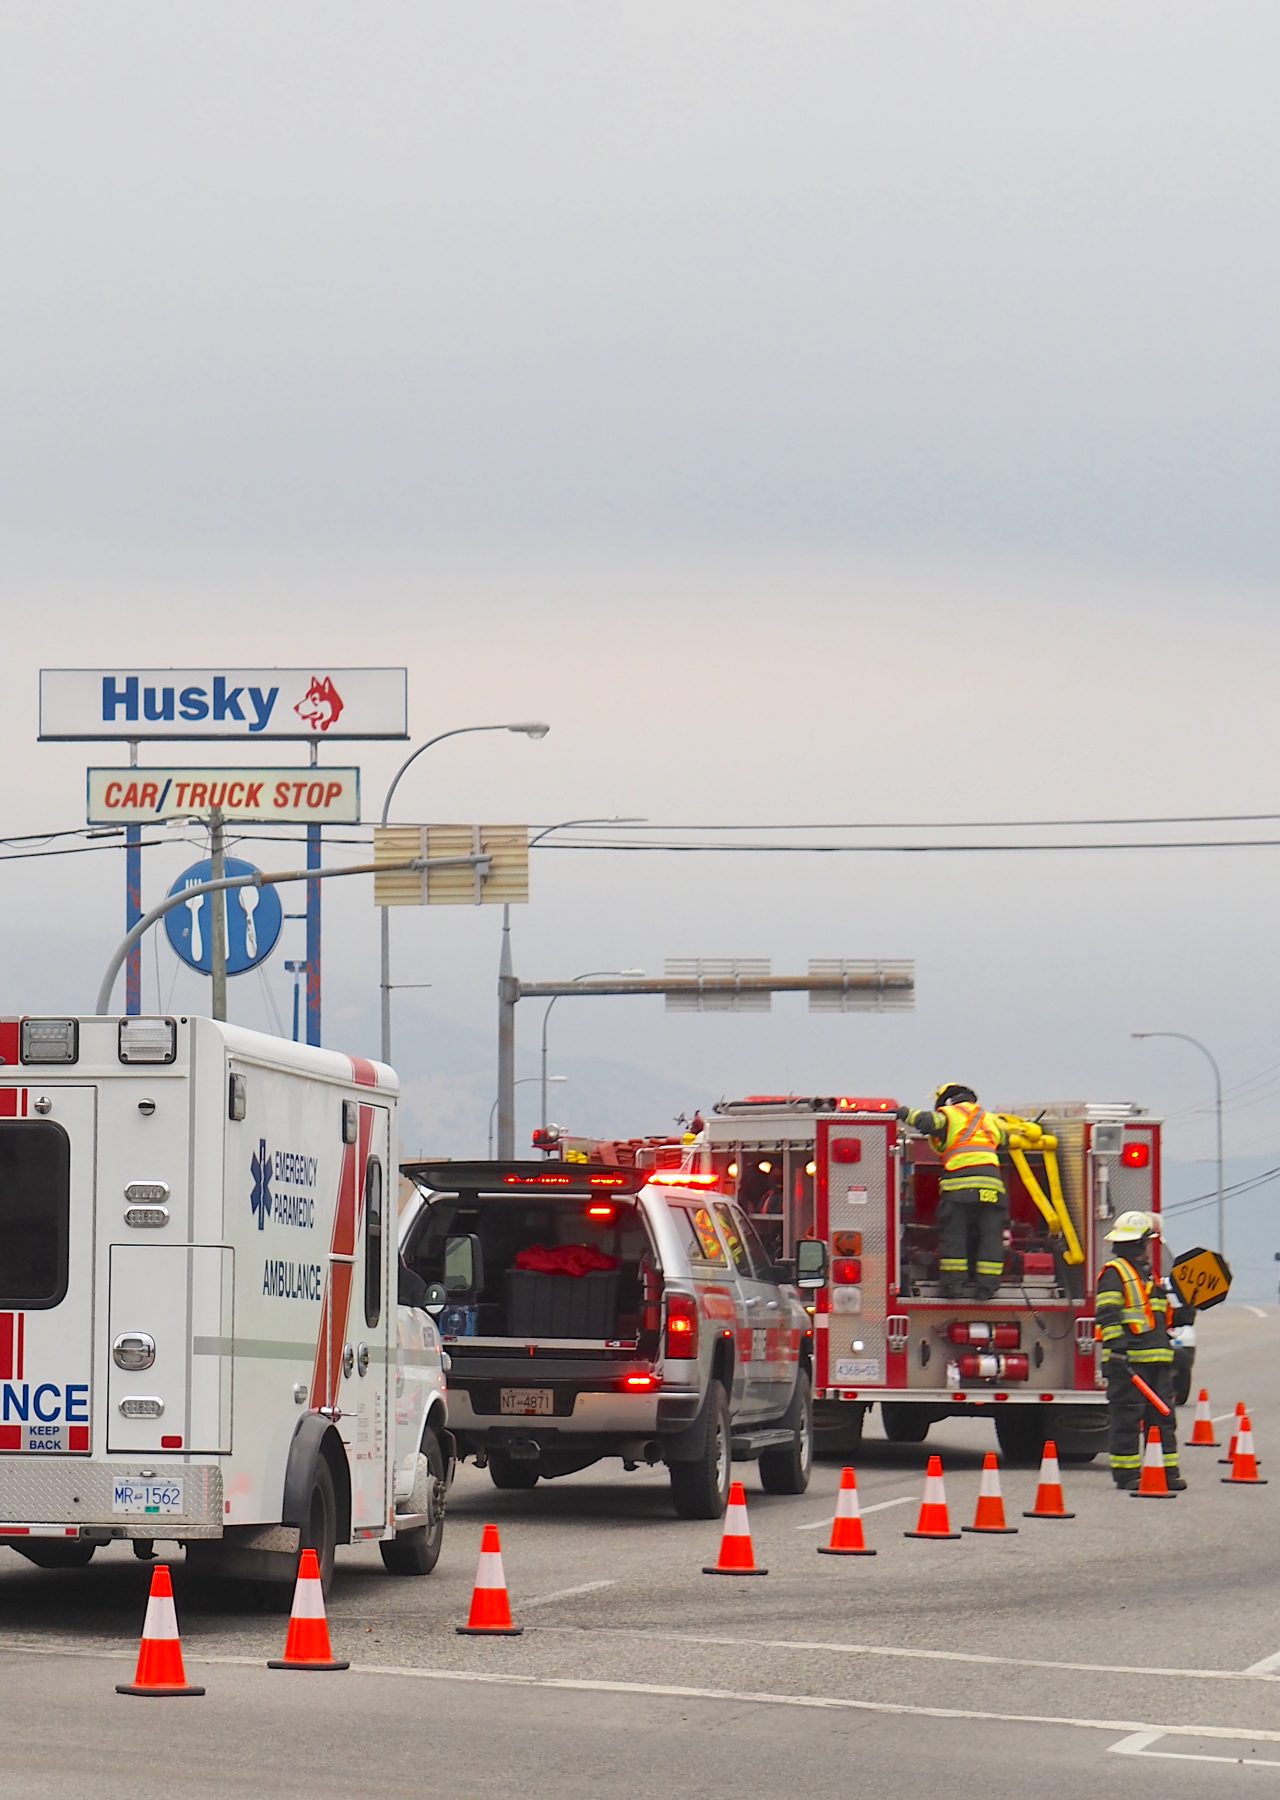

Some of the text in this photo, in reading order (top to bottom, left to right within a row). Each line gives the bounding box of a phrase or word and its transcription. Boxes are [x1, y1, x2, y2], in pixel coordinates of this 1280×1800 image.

[102, 676, 280, 732] Husky
[273, 782, 343, 809] STOP
[275, 1151, 319, 1188] EMERGENCY
[274, 1193, 315, 1229] PARAMEDIC
[262, 1259, 321, 1301] AMBULANCE
[1178, 1264, 1221, 1292] SLOW
[29, 1425, 61, 1437] KEEP
[29, 1439, 62, 1450] BACK
